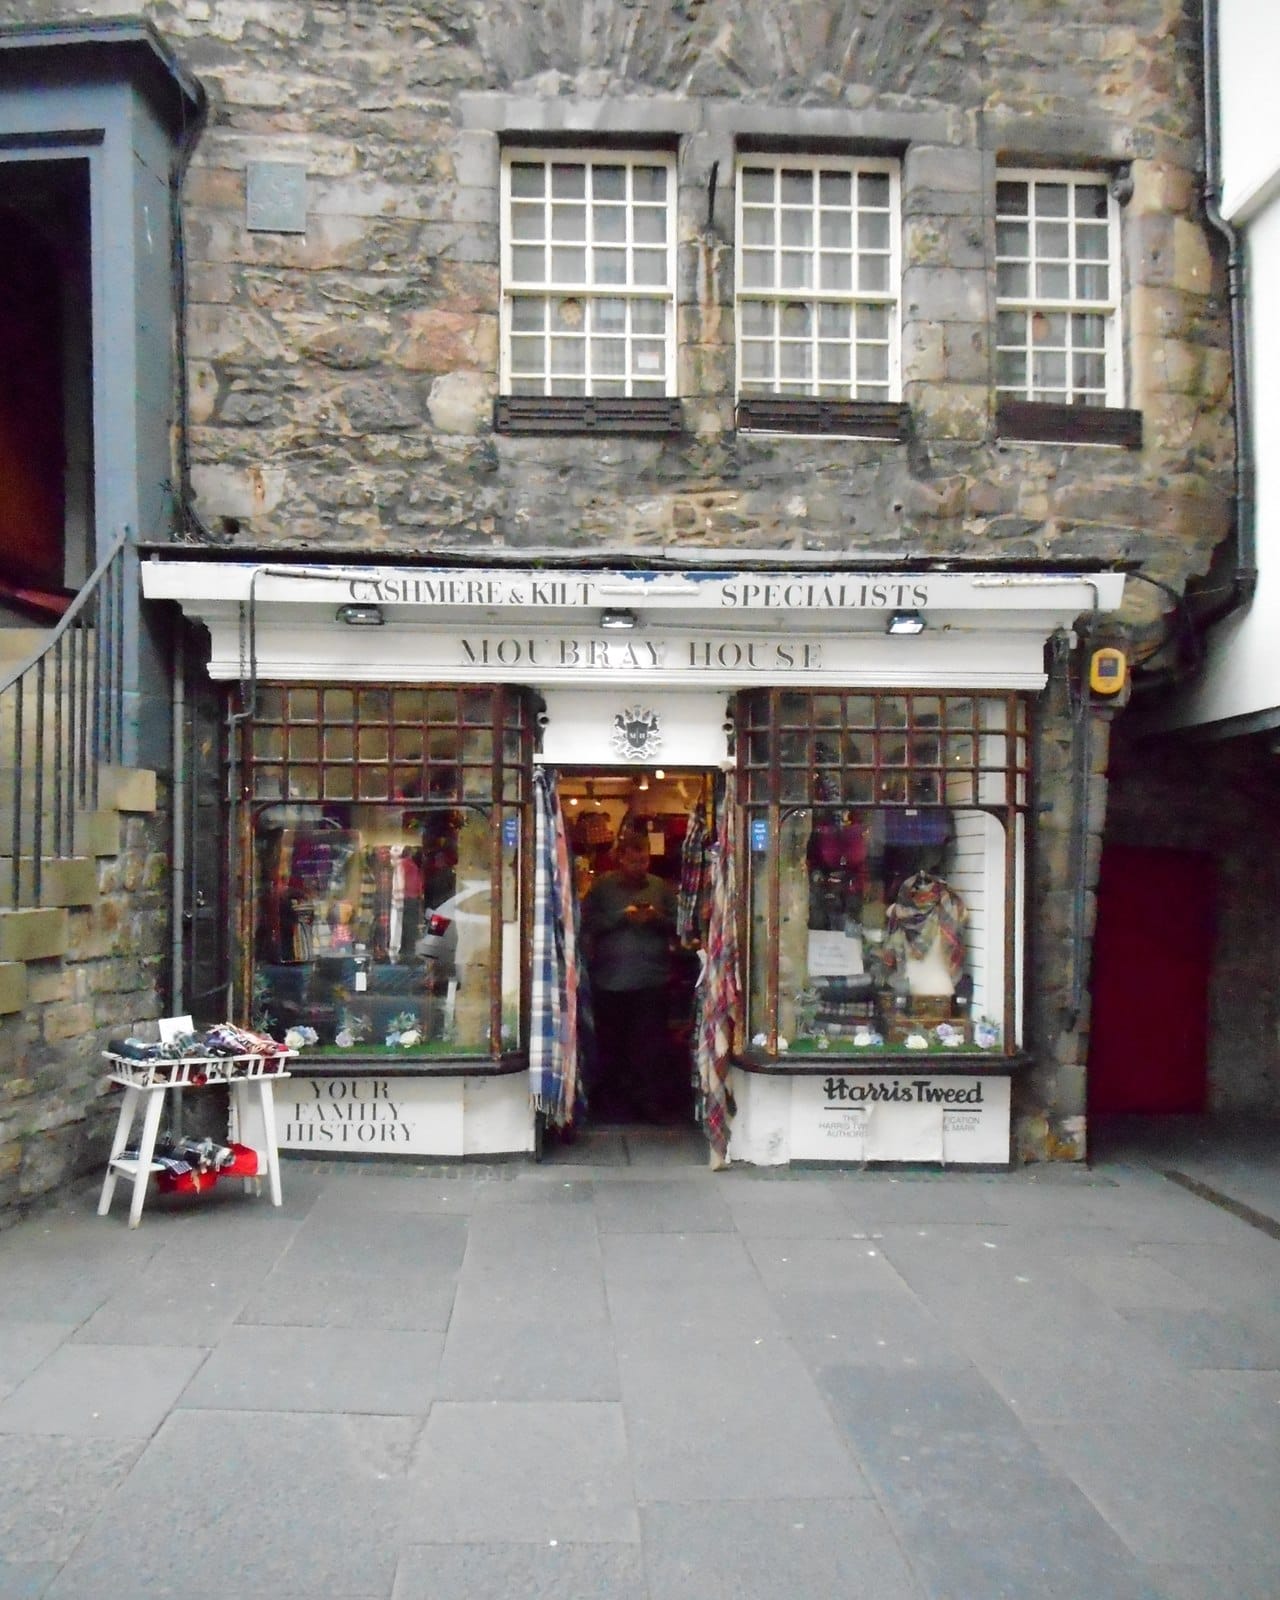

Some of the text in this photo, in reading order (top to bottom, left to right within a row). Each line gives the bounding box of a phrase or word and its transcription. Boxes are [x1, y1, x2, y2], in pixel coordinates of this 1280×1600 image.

[349, 579, 596, 606] CASHMERE & KILT
[721, 583, 929, 608] SPECIALISTS
[461, 638, 823, 670] MOUBRAY HOUSE
[310, 1080, 389, 1099] YOUR
[823, 1076, 985, 1104] Harris Tweed
[295, 1102, 404, 1121] FAMILY
[286, 1123, 416, 1142] HISTORY
